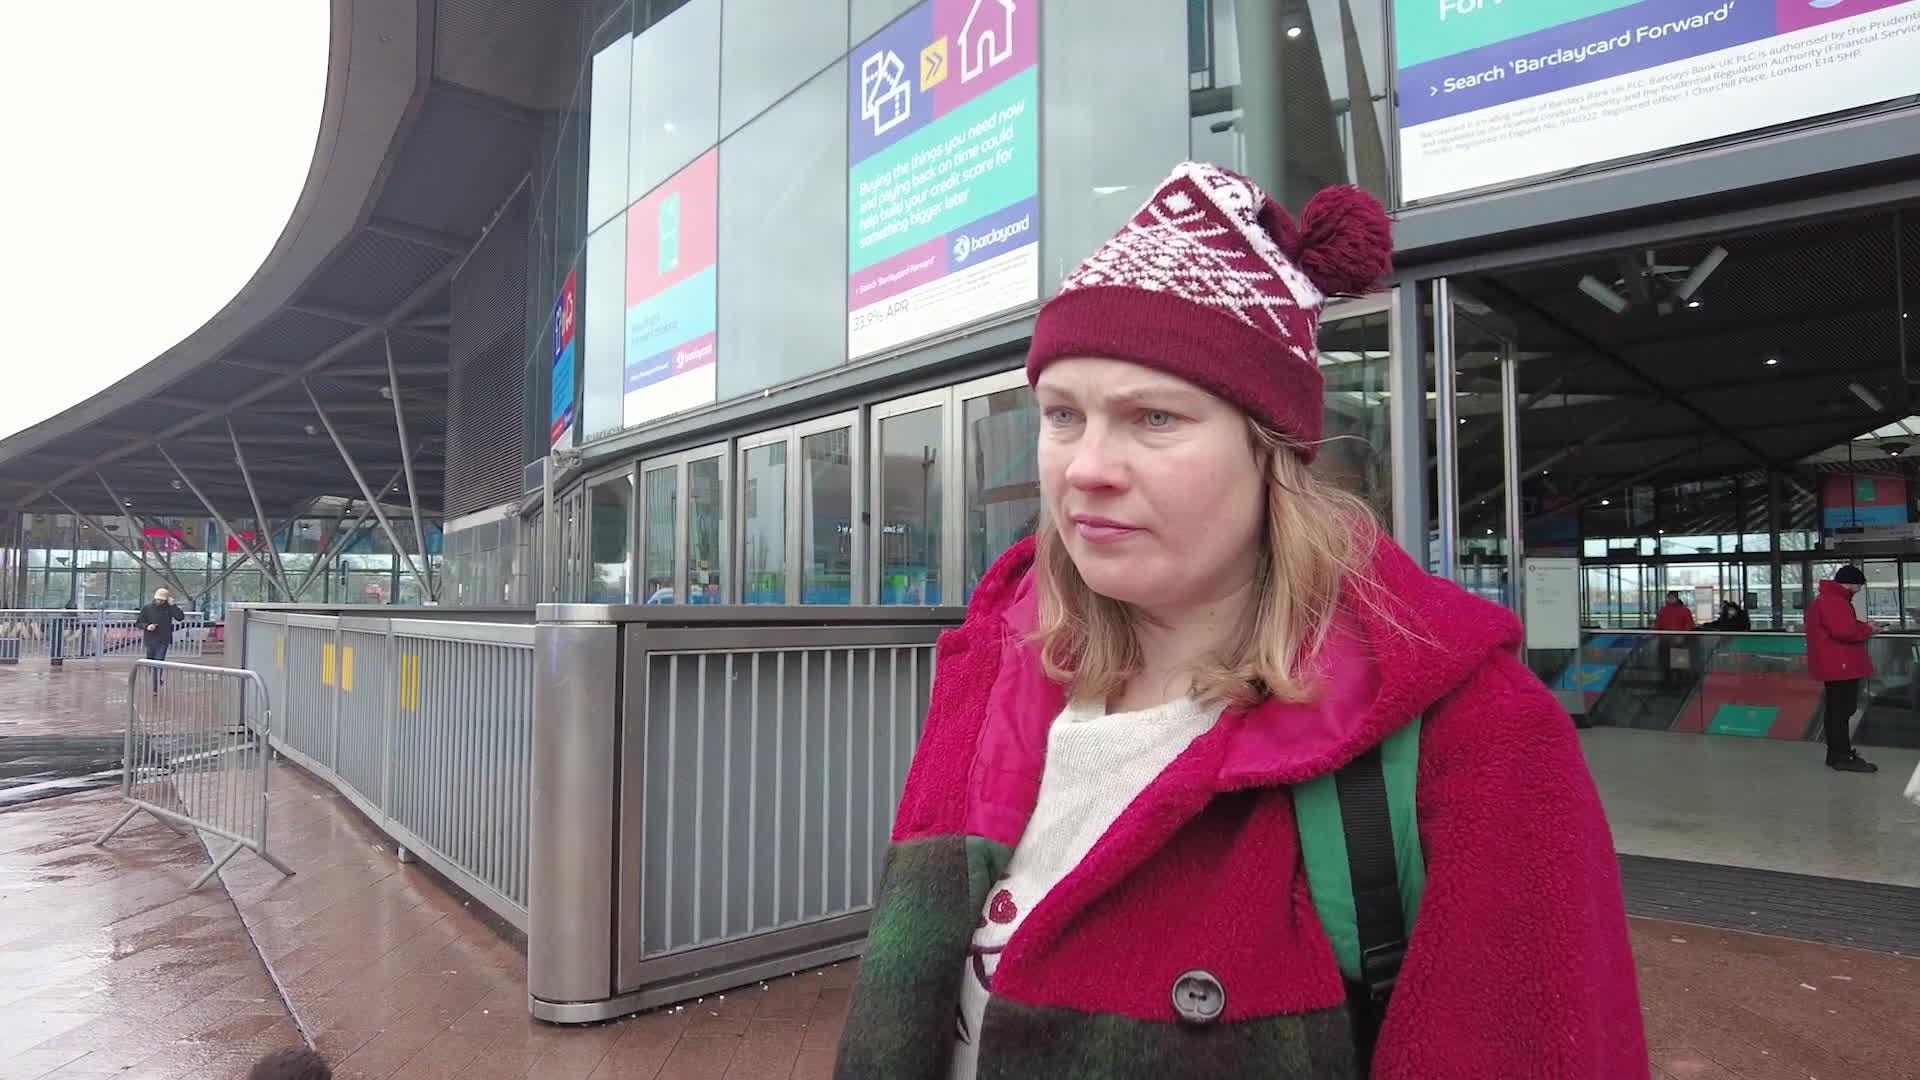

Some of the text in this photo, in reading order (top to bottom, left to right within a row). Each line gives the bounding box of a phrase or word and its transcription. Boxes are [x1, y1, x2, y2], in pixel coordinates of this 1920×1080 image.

[1443, 1, 1735, 93] Search 'Barclaycard Forward'
[1692, 63, 1716, 74] Bank
[1719, 57, 1734, 68] UK
[1737, 51, 1755, 63] PLC
[1769, 35, 1828, 57] authorised
[1831, 31, 1845, 44] by
[1847, 23, 1867, 36] the
[1713, 62, 1768, 81] Regulation
[1770, 49, 1822, 68] Authority
[1824, 33, 1878, 54] (Financial
[1771, 62, 1812, 78] London
[1815, 55, 1834, 68] E14
[859, 98, 1025, 195] Buying the things you need now
[859, 124, 1014, 213] and paying back on time could
[859, 146, 1016, 233] help build your credit score for
[859, 185, 970, 249] something bigger later
[970, 213, 1030, 251] barclaycard
[853, 298, 909, 332] 33.9% APR
